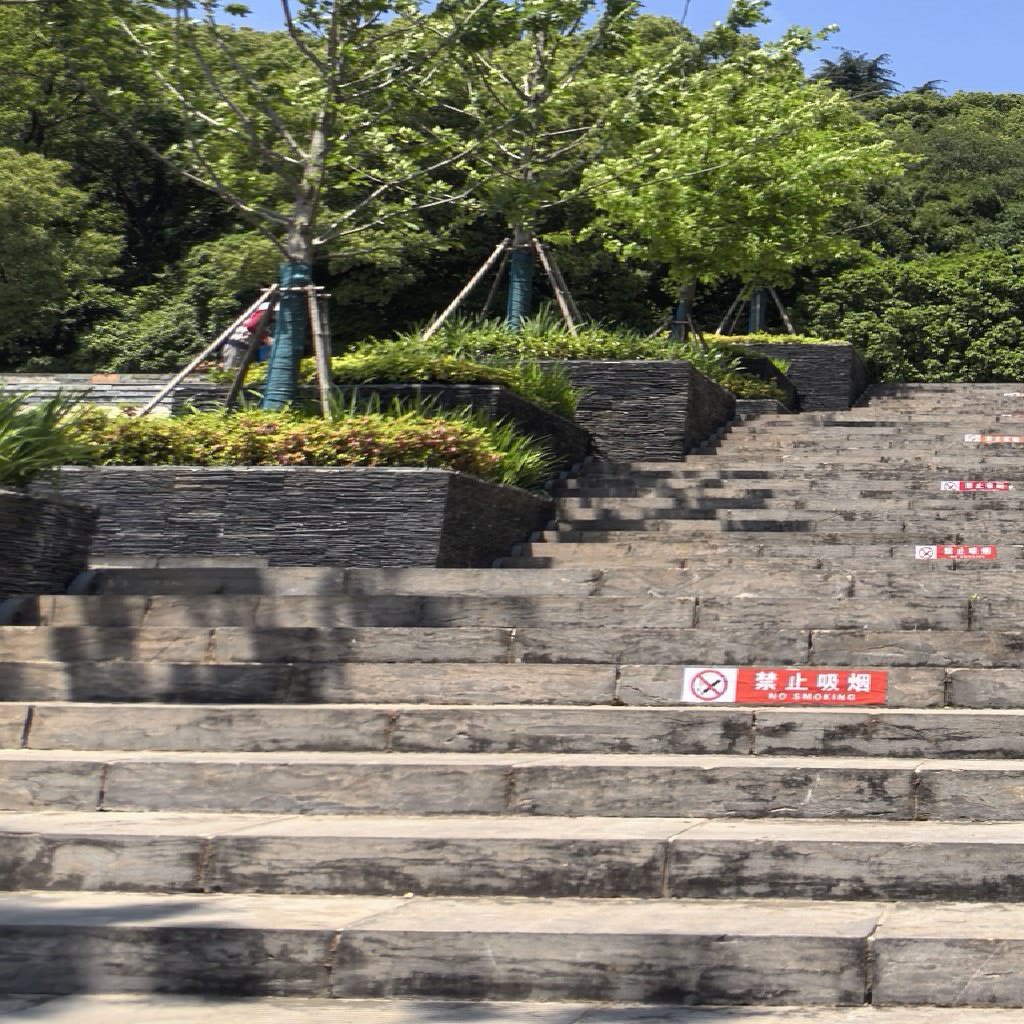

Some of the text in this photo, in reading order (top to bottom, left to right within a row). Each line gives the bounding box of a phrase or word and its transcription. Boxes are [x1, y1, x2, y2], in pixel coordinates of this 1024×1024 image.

[754, 671, 871, 692] 禁止吸烟
[768, 692, 856, 701] NO SMOKING
